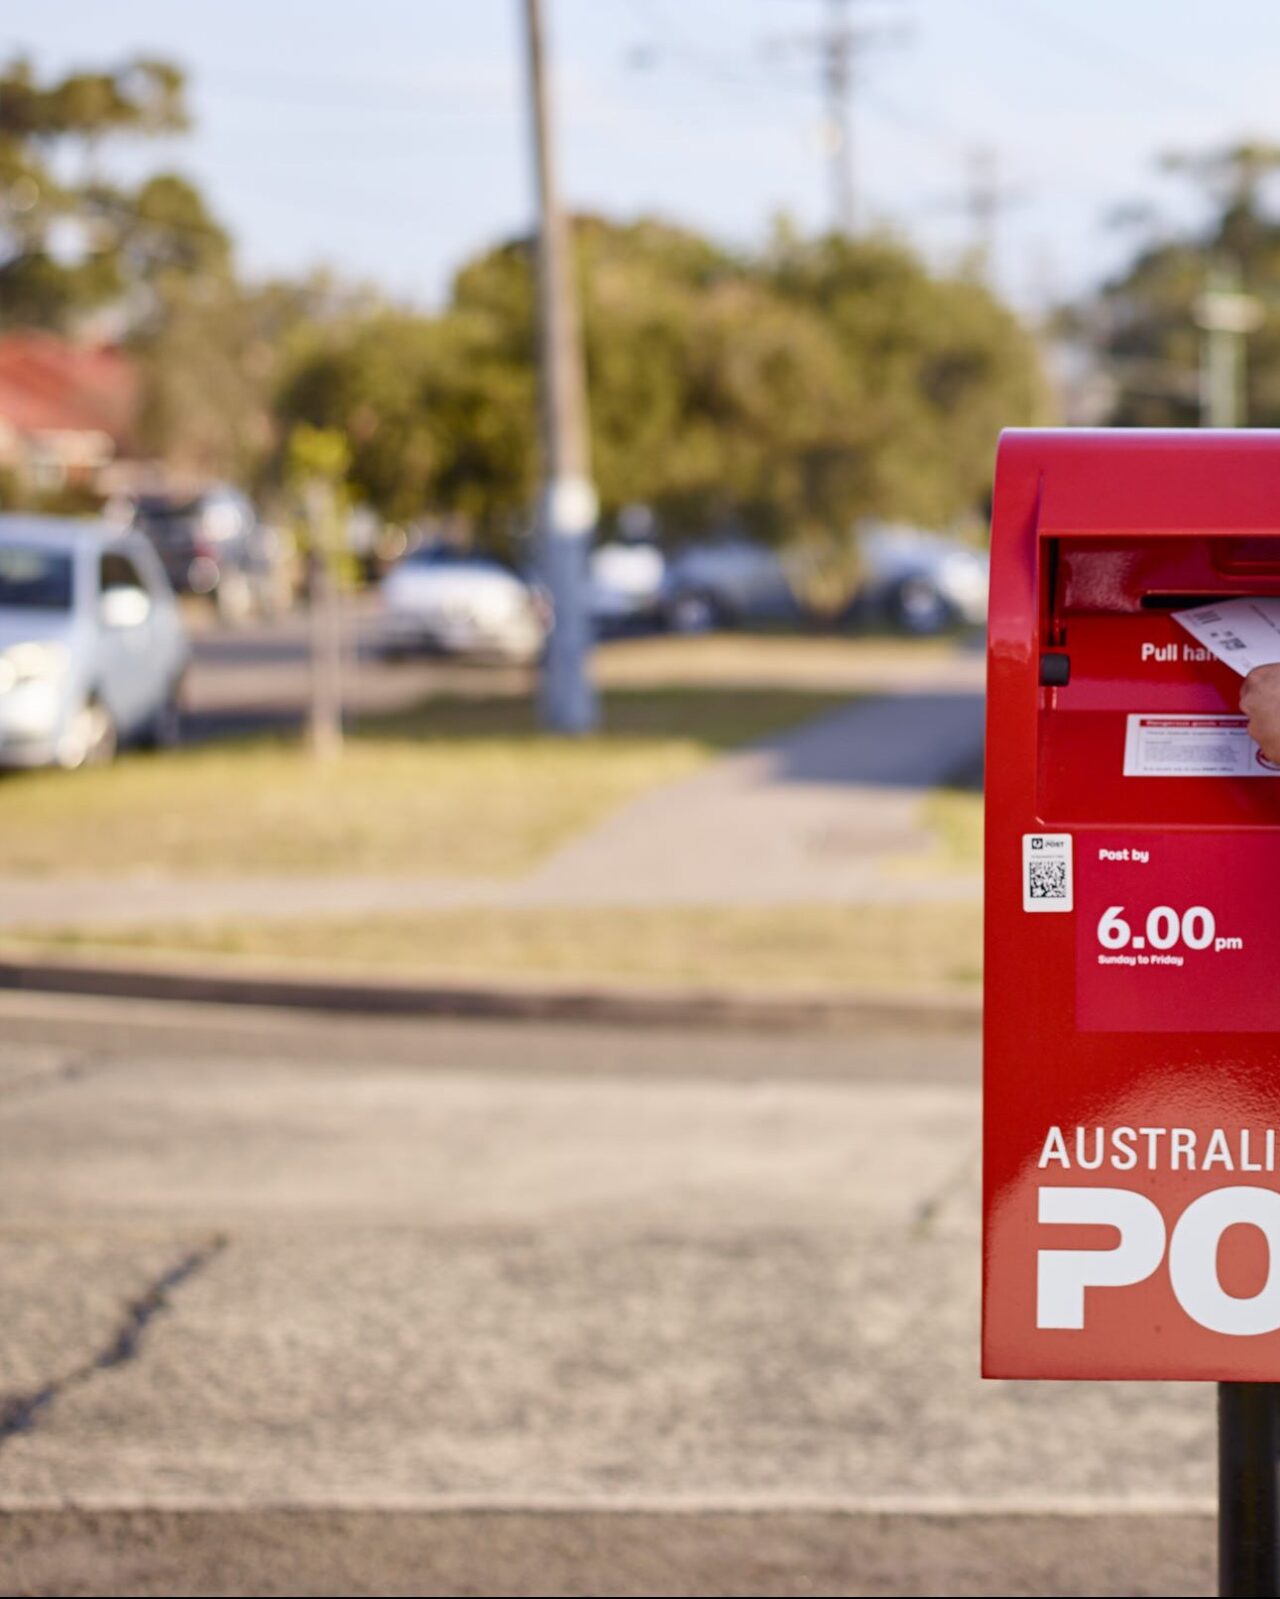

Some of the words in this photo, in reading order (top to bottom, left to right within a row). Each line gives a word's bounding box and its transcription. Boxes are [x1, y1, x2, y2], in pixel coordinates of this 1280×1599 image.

[1141, 643, 1178, 661] Pull
[1098, 849, 1129, 861] Post
[1132, 849, 1150, 863] by
[1098, 955, 1136, 966] Sunday
[1138, 955, 1149, 964] to
[1150, 955, 1184, 966] Friday
